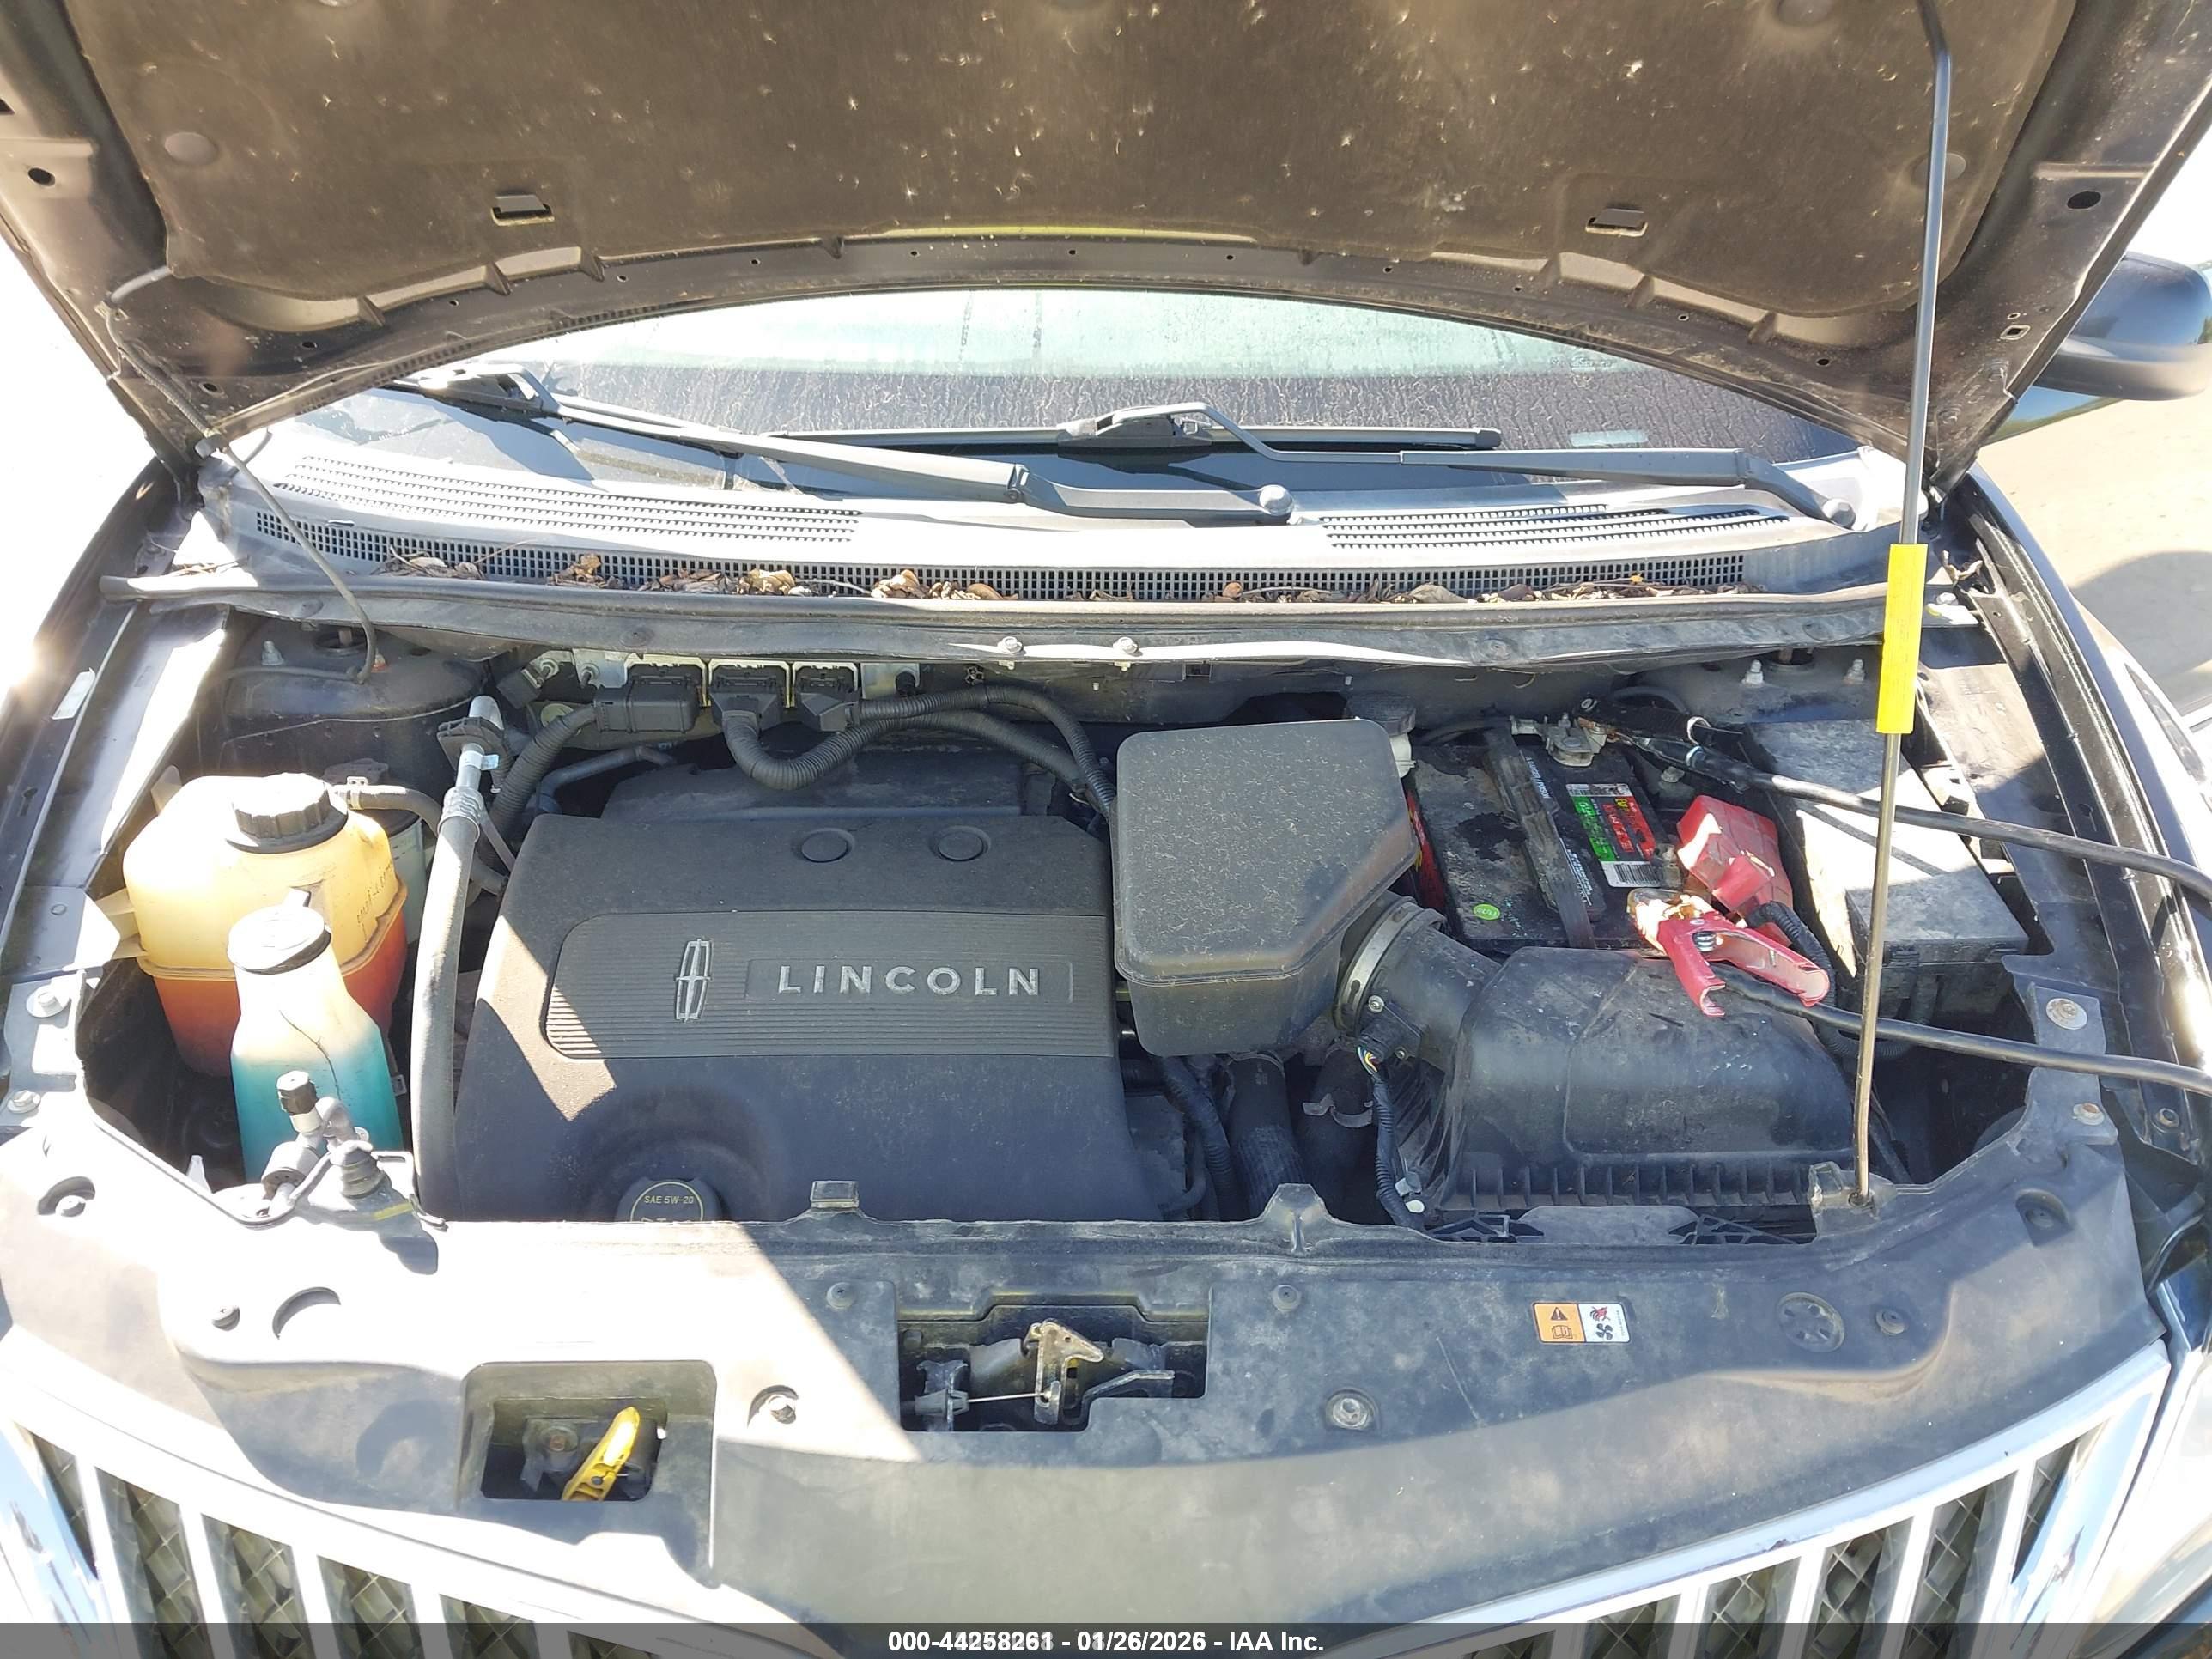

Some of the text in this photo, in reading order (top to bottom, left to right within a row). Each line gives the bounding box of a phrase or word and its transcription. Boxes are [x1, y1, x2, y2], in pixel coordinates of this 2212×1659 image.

[778, 965, 1039, 996] LINCOLN
[644, 1195, 694, 1204] SAE 5W-20
